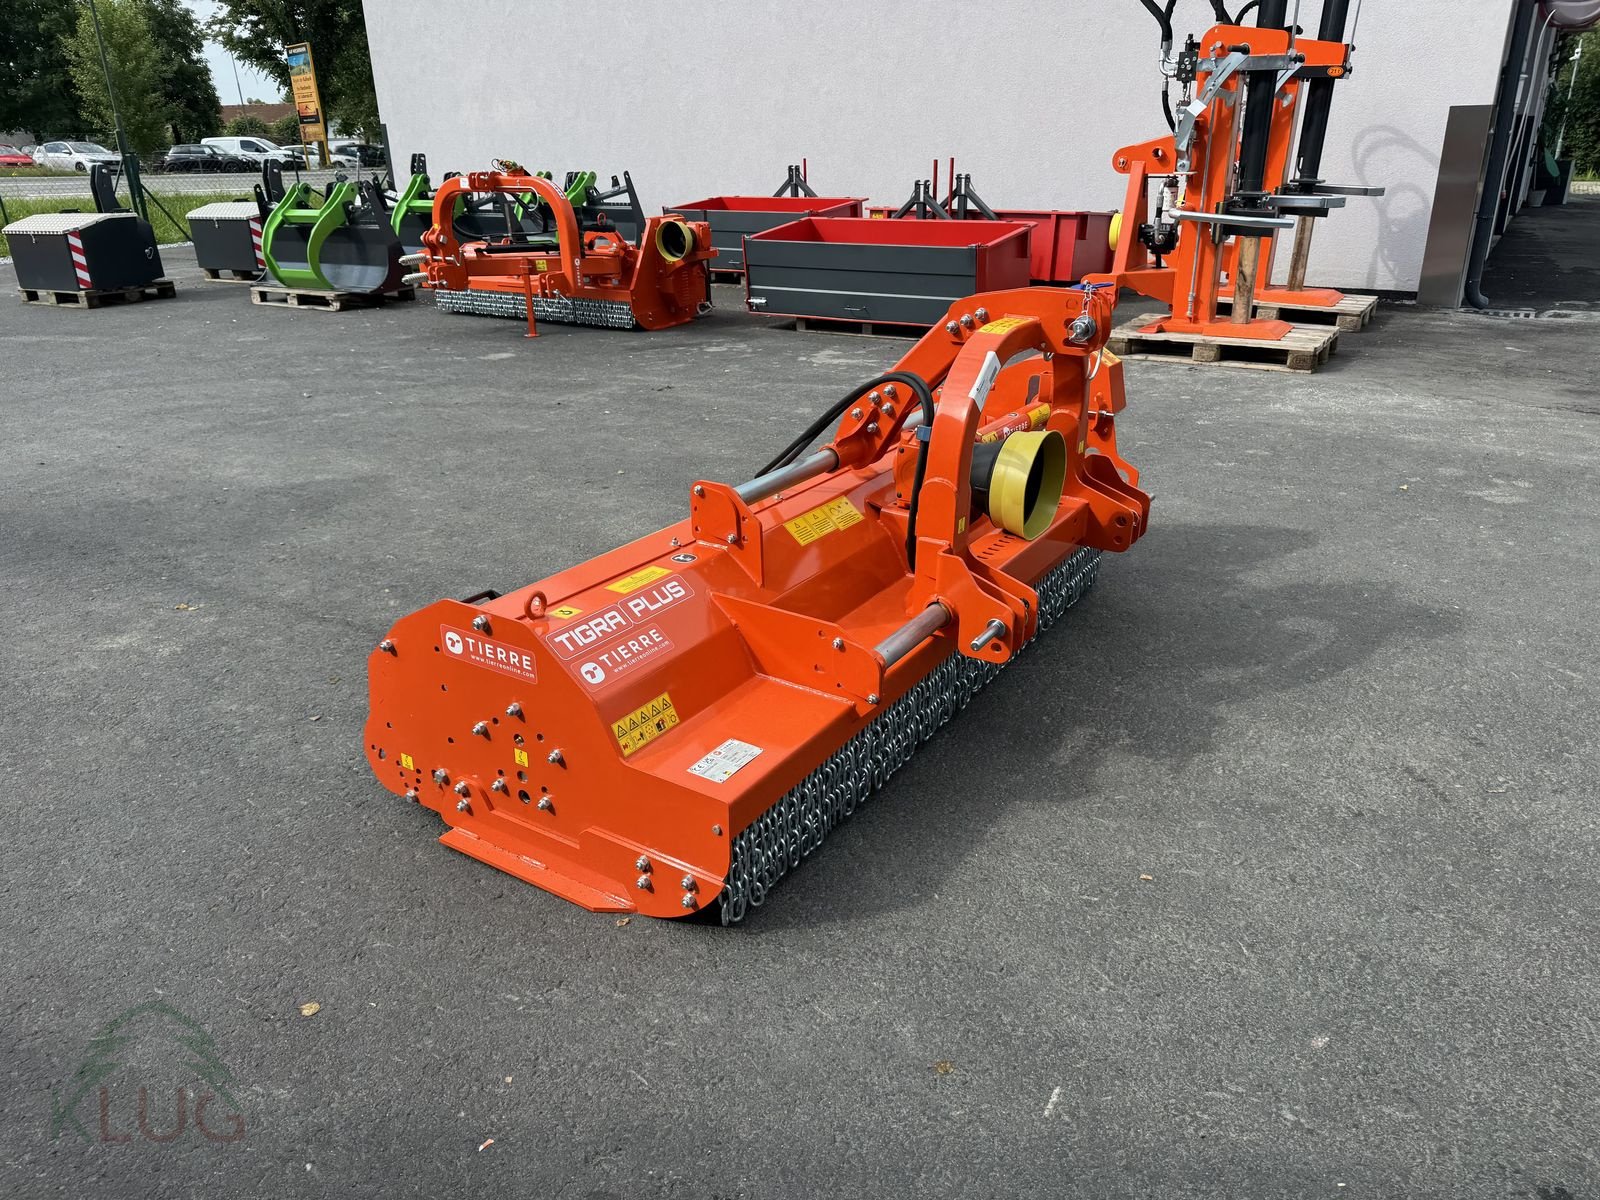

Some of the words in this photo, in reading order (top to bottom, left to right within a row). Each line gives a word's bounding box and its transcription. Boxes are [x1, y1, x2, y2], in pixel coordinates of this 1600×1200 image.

[553, 610, 627, 652] TIGRA
[627, 581, 686, 618] PLUS
[465, 637, 533, 671] TIERRE
[598, 628, 664, 667] TIERRE
[613, 640, 670, 673] www.tierreonline.com
[470, 654, 535, 679] www.tierreonline.com
